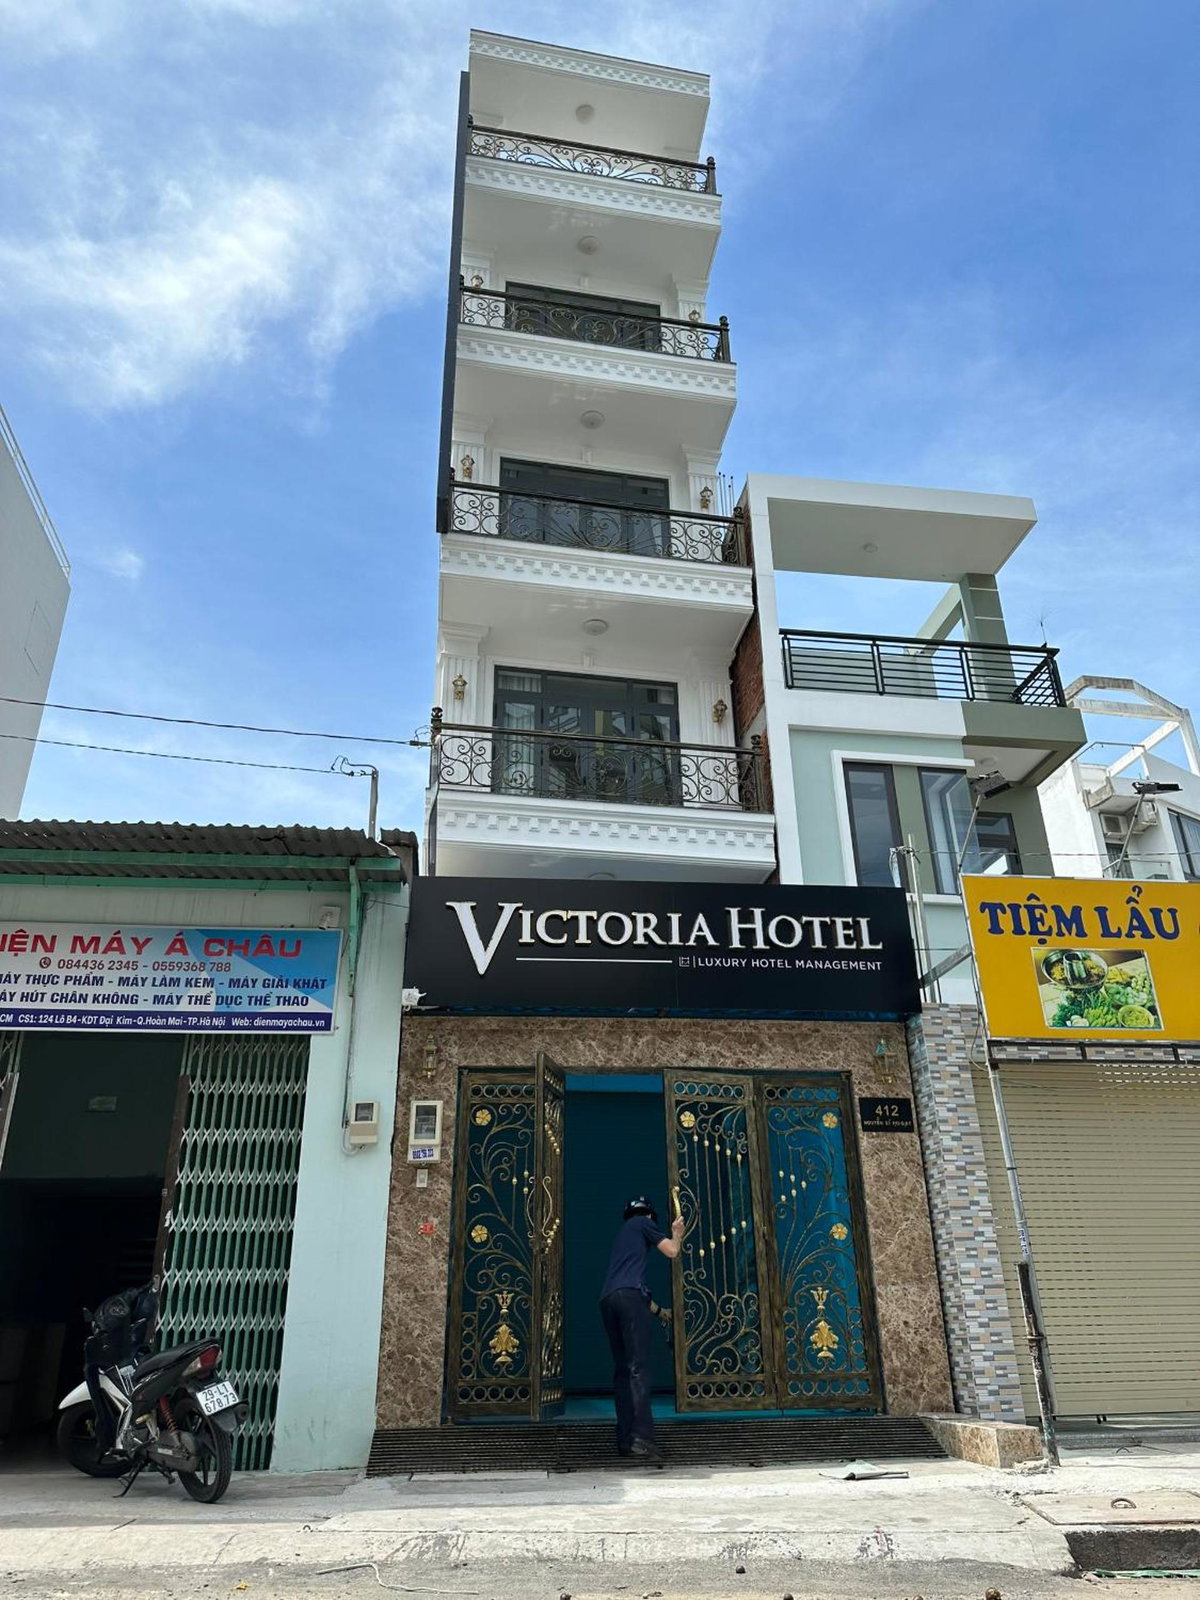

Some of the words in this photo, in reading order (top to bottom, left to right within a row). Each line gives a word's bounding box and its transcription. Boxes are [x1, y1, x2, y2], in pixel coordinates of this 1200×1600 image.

[979, 892, 1088, 945] TIỆM
[1093, 885, 1181, 940] LẨU
[70, 930, 153, 956] MÁY
[164, 928, 189, 956] Á
[203, 933, 303, 958] CHÂU
[445, 900, 720, 976] VICTORIA
[725, 906, 883, 950] HOTEL
[57, 958, 105, 971] 084436
[107, 959, 139, 971] 2345
[152, 960, 206, 972] 0559368
[209, 961, 231, 973] 788
[698, 956, 747, 968] LUXURY
[751, 958, 792, 969] HOTEL
[795, 959, 883, 971] MANAGEMENT
[25, 973, 60, 987] THỰC
[63, 972, 105, 987] PHẨM
[117, 975, 148, 988] MÁY
[151, 975, 181, 988] LÀM
[185, 977, 215, 988] KEM
[228, 976, 258, 989] MÁY
[262, 975, 289, 989] GIẢI
[292, 977, 328, 990] KHÁT
[20, 990, 47, 1003] HÚT
[50, 991, 89, 1004] CHÂN
[92, 991, 139, 1005] KHÔNG
[152, 993, 183, 1006] MÁY
[187, 991, 213, 1006] THỂ
[215, 994, 243, 1008] DỤC
[247, 991, 273, 1007] THỂ
[275, 995, 309, 1007] THAO
[18, 1014, 37, 1023] CS1:
[39, 1014, 54, 1024] 124
[211, 1016, 226, 1029] Nội
[231, 1017, 252, 1027] Web:
[253, 1017, 326, 1029] dienmayachau.vn
[875, 1104, 900, 1117] 412
[202, 1383, 230, 1402] 29-L1
